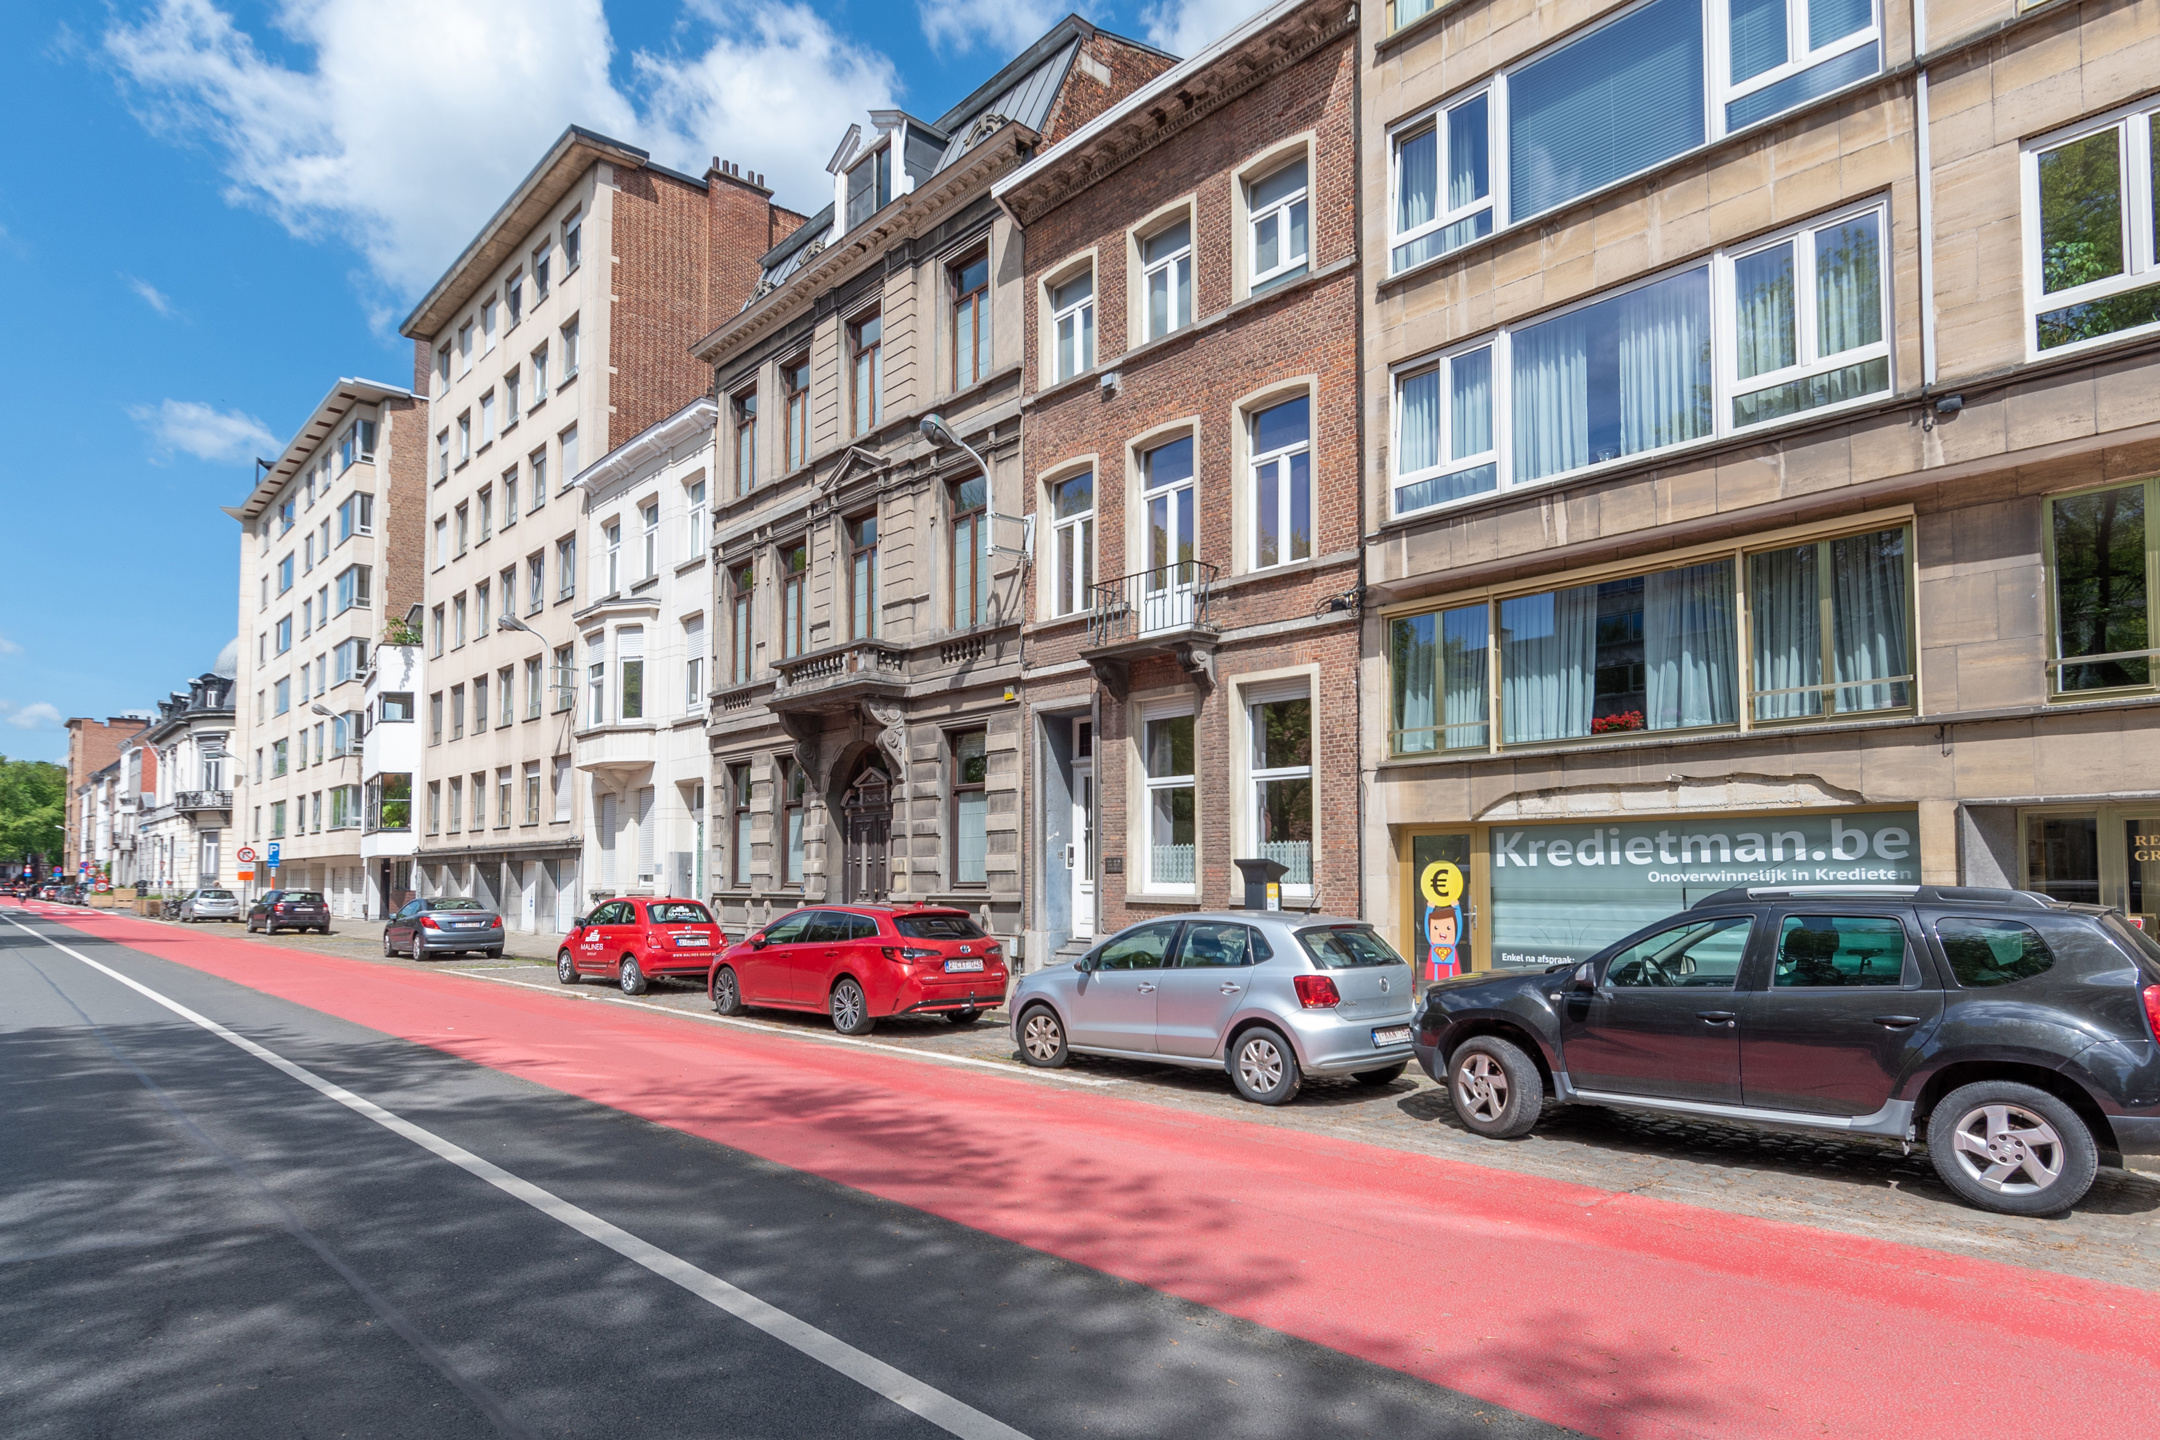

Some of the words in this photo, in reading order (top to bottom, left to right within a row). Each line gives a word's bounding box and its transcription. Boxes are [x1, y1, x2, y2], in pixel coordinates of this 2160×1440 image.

[1495, 818, 1911, 867] Kredietman.be
[269, 845, 278, 856] P
[1647, 868, 1788, 884] Onoverwinnelijk
[1792, 868, 1809, 881] in
[1815, 867, 1912, 881] Kredieten
[580, 943, 604, 951] MALINES
[1501, 952, 1524, 962] Enkel
[1525, 955, 1536, 963] na
[1537, 954, 1575, 965] afspraak:
